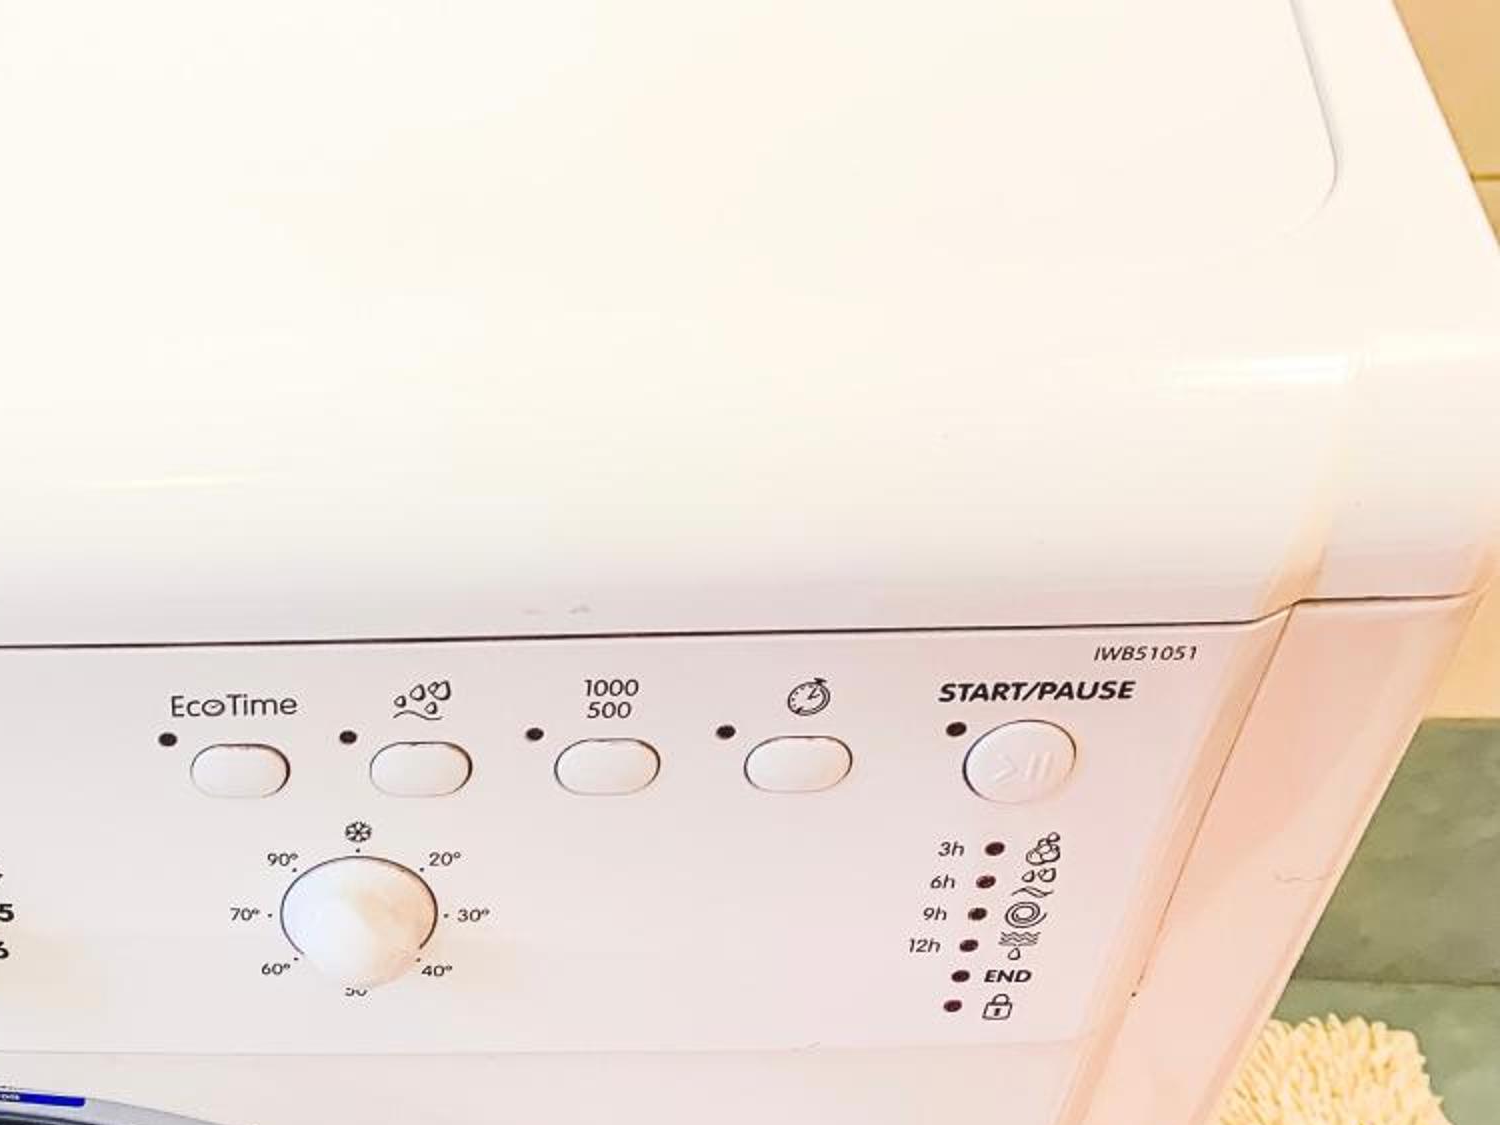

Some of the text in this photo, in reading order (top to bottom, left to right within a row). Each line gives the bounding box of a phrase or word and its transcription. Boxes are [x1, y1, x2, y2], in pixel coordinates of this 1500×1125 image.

[1093, 645, 1198, 661] IWB51051
[583, 678, 639, 697] 1000
[937, 680, 1137, 702] START/PAUSE
[170, 694, 298, 717] EcoTime
[587, 701, 632, 719] 500
[937, 840, 965, 857] 3h
[267, 854, 298, 866] 90°
[429, 852, 462, 866] 20°
[930, 874, 956, 889] 6h
[230, 907, 260, 921] 70°
[457, 909, 490, 922] 30°
[923, 906, 947, 921] 9h
[909, 938, 941, 953] 12h
[261, 963, 291, 976] 60°
[421, 965, 453, 977] 40°
[983, 969, 1032, 983] END
